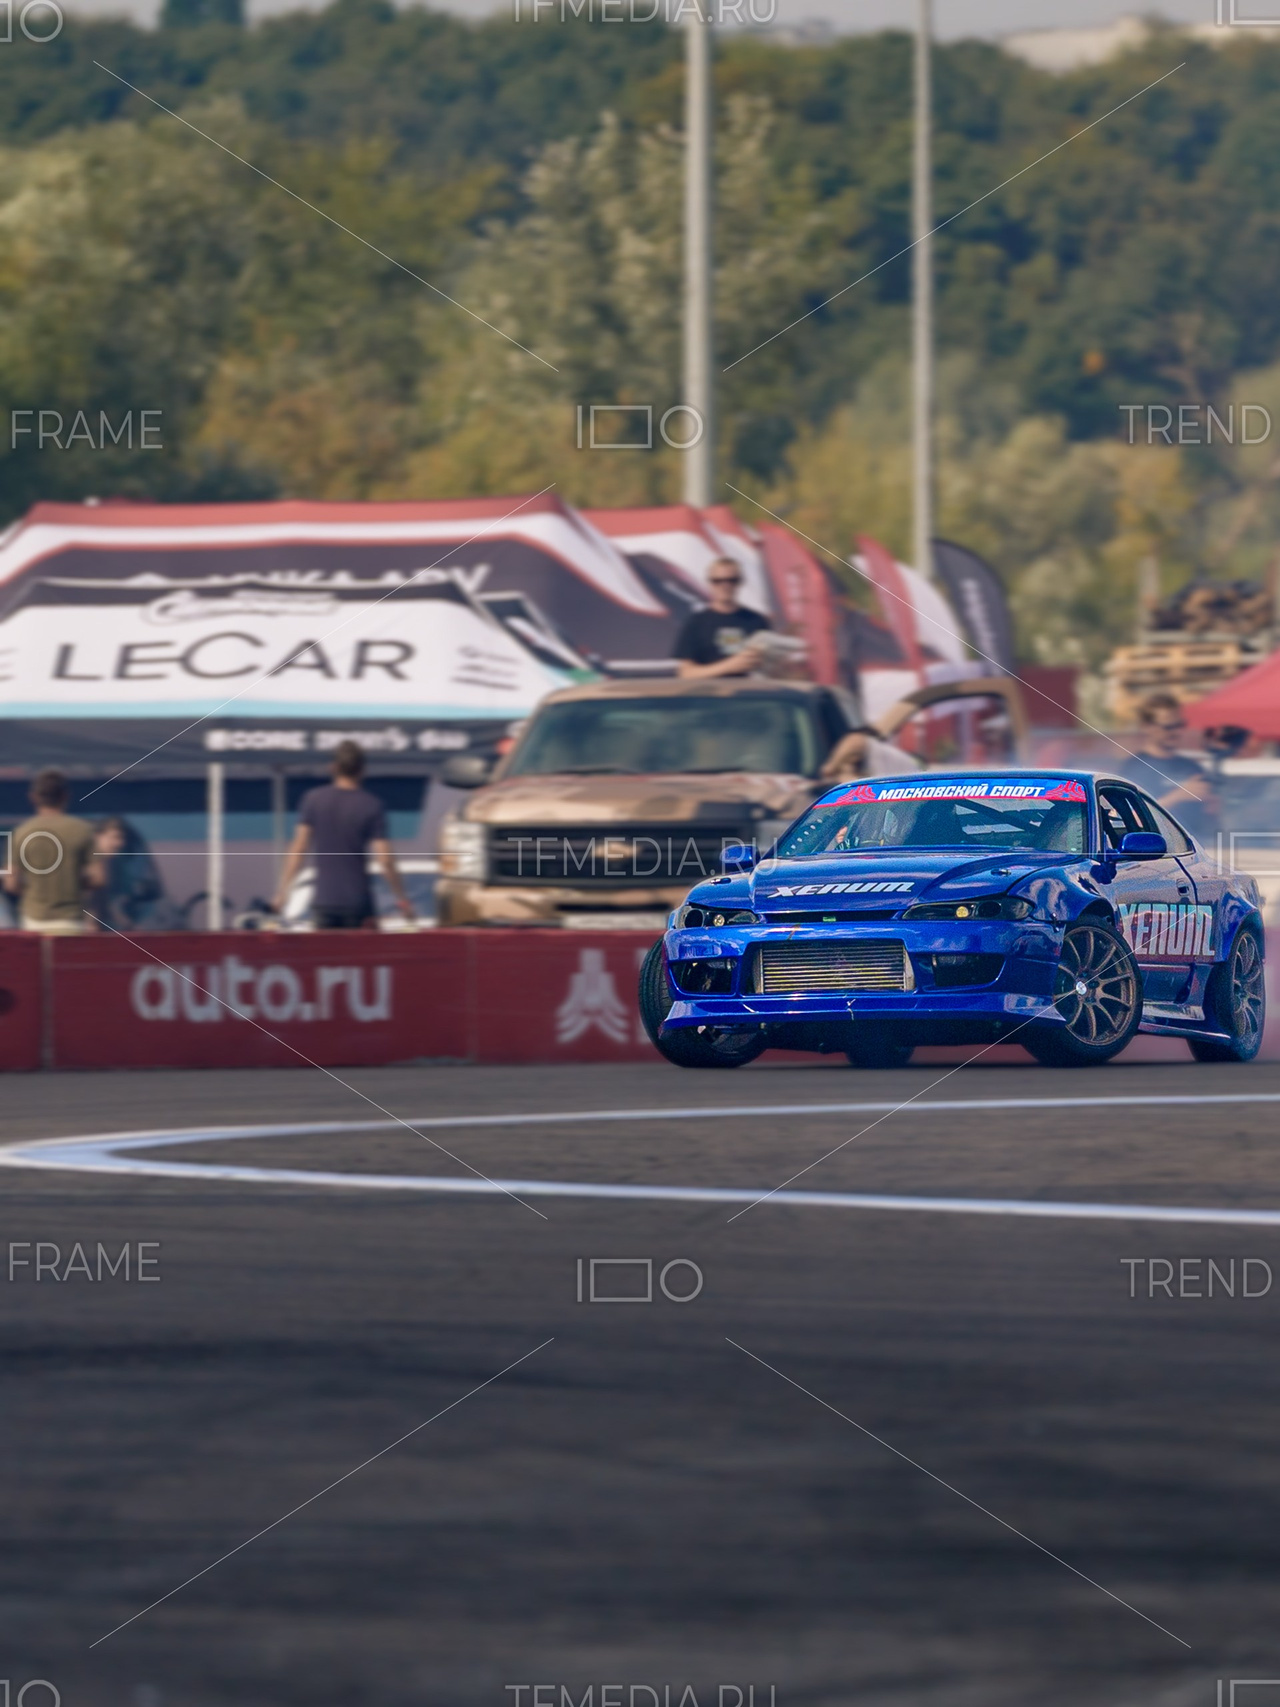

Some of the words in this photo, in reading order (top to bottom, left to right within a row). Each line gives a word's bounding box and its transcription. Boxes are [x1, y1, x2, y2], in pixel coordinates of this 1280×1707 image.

[52, 631, 419, 682] LECAR
[877, 783, 989, 801] МОСКОВСКИЙ
[990, 785, 1046, 798] СПОРТ
[767, 881, 915, 898] XENUM
[130, 953, 394, 1023] auto.ru
